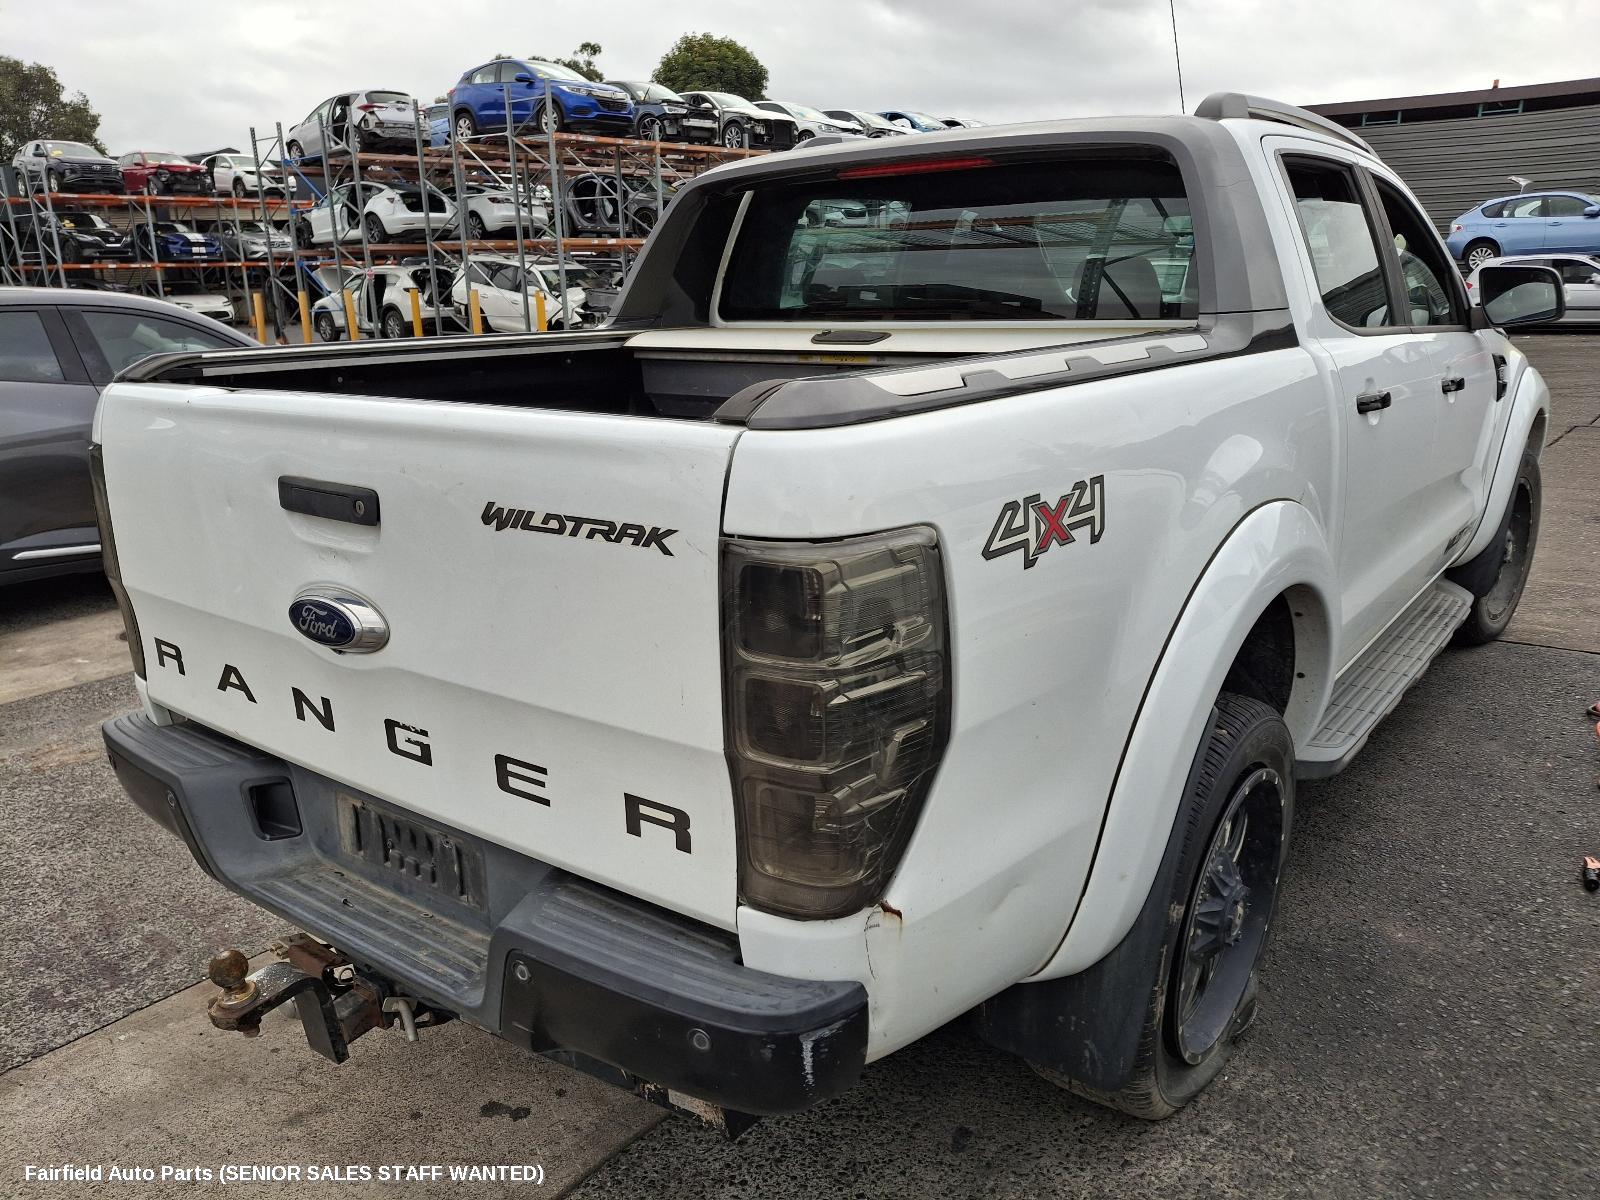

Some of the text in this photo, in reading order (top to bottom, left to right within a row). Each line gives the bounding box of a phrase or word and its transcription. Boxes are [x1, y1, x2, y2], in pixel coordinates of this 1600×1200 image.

[481, 501, 679, 557] WILDTRAK
[299, 605, 337, 638] Ford
[154, 637, 693, 854] RANGER
